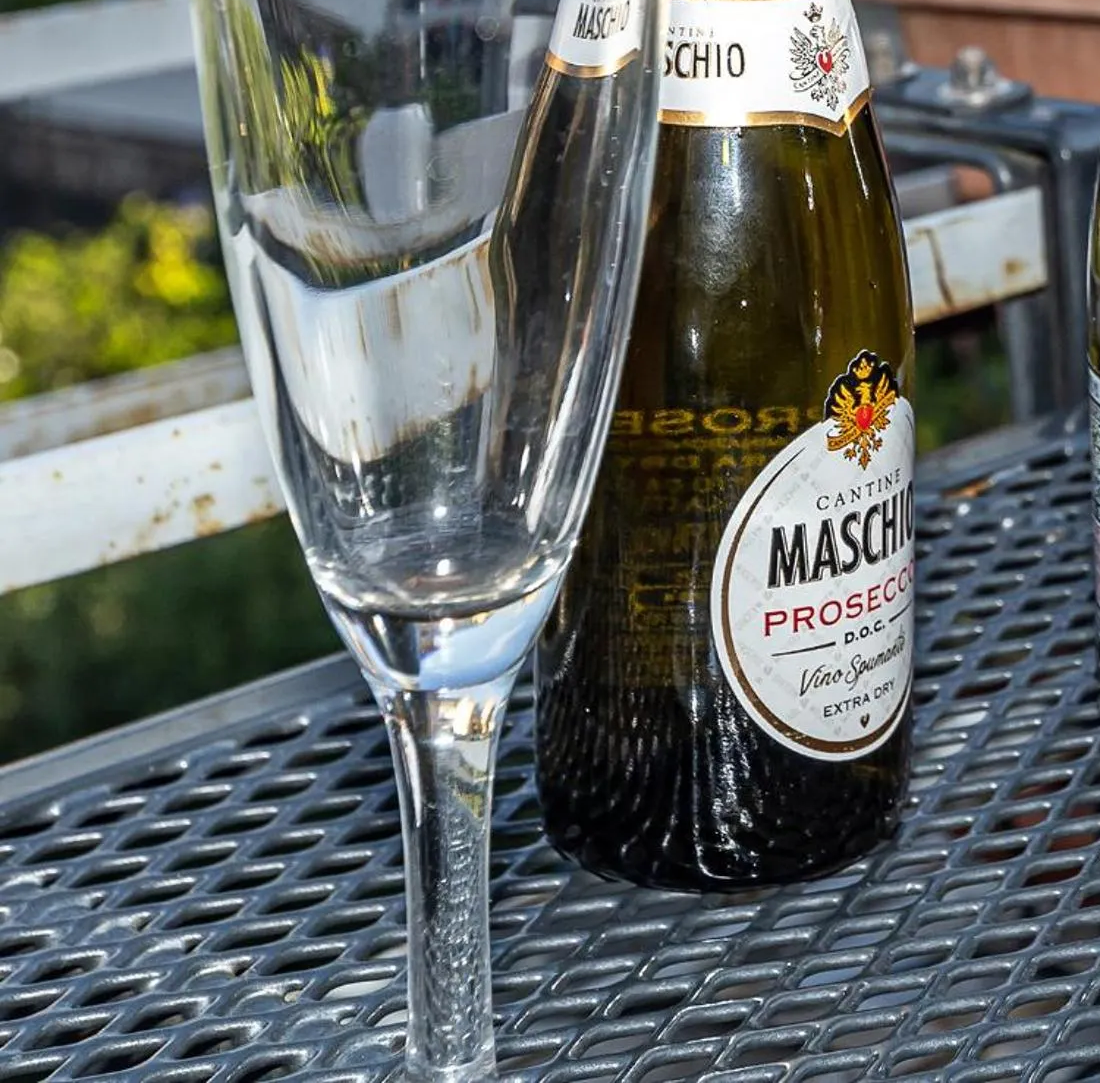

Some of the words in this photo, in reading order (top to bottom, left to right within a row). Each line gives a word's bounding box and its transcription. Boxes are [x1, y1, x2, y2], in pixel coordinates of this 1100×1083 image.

[664, 40, 745, 79] SCHIO
[816, 468, 901, 511] CANTINE
[767, 479, 914, 589] MASCHIO
[844, 619, 886, 645] D.O.C.
[799, 664, 844, 697] Vino
[823, 693, 871, 718] EXTRA
[873, 677, 896, 700] DRY
